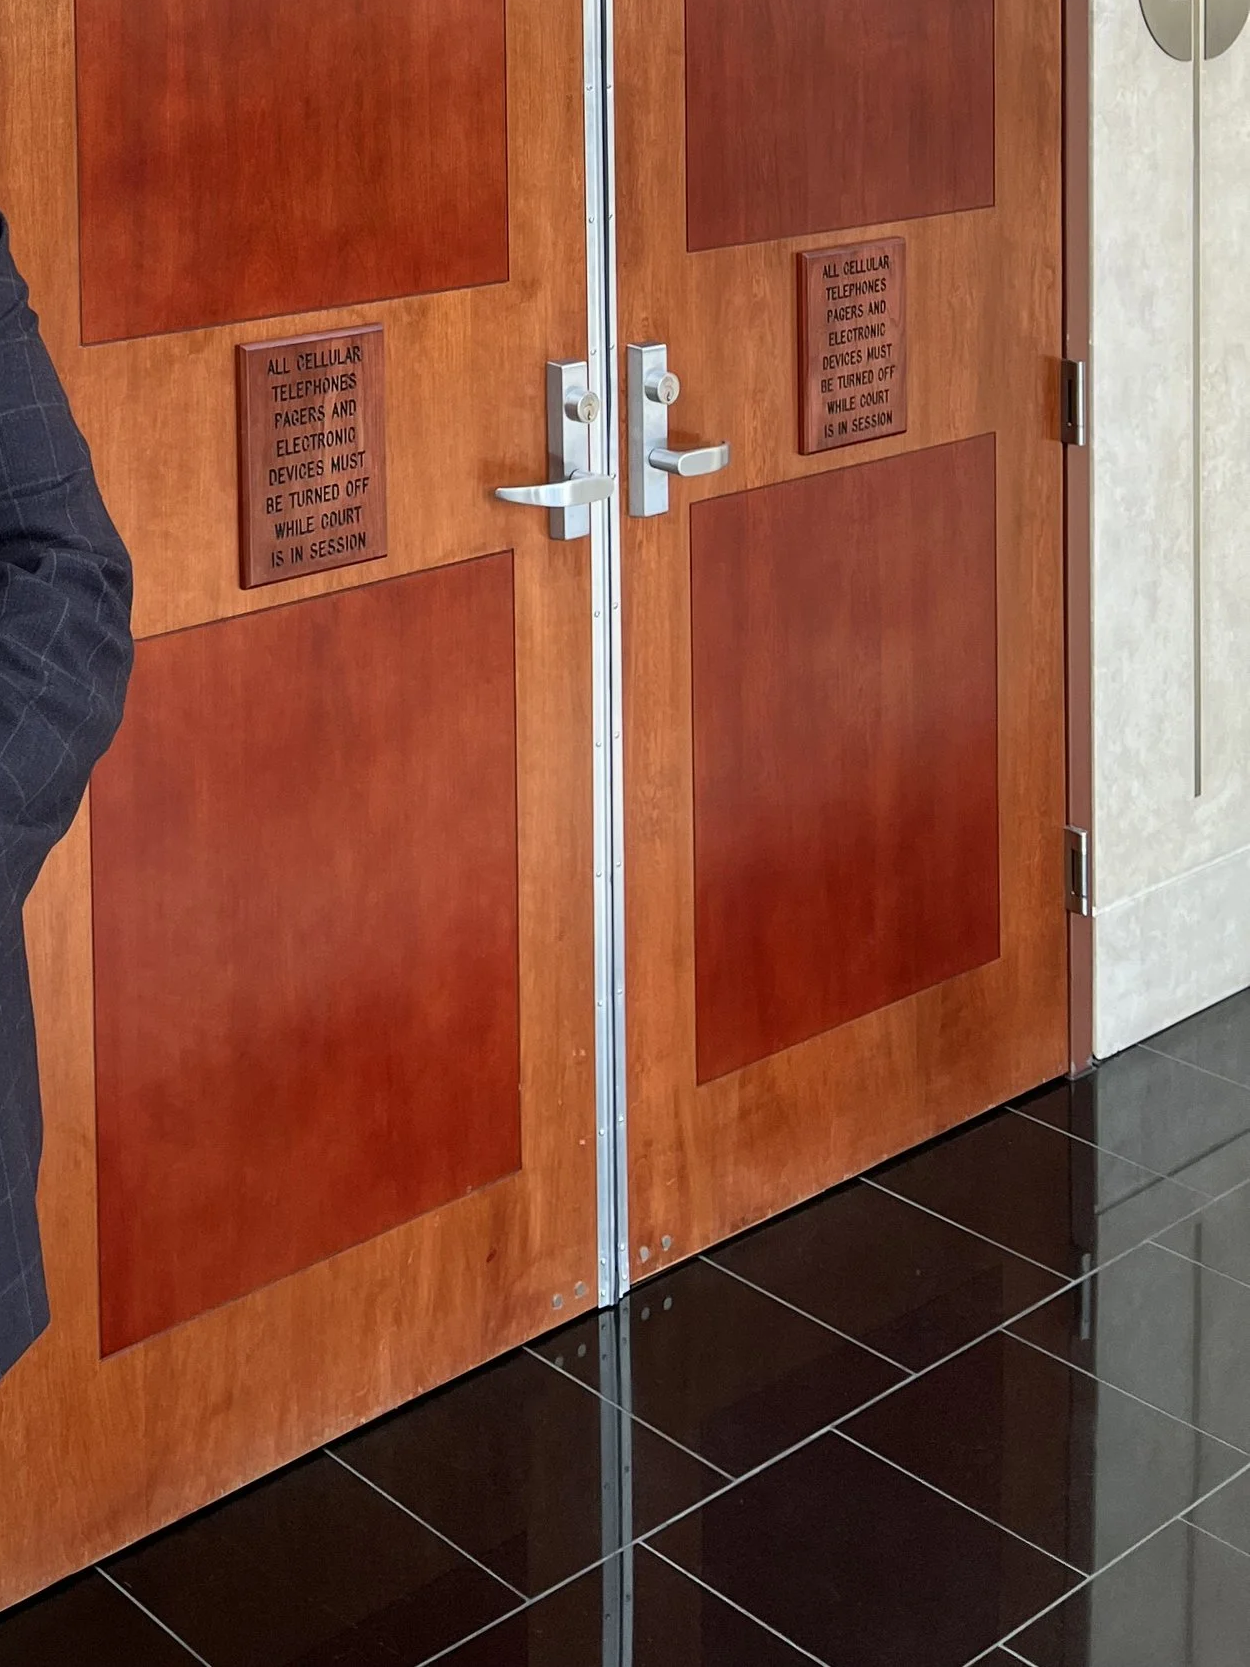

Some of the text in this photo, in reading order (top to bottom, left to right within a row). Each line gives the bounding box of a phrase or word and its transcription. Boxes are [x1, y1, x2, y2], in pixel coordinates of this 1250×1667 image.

[822, 255, 890, 279] ALL CELLULAR
[826, 278, 887, 301] TELEPHONES
[827, 299, 886, 323] PAGERS AND
[828, 322, 886, 347] ELECTRONIC
[267, 345, 362, 375] ALL CELLULAR
[822, 343, 892, 371] DEVICES MUST
[271, 372, 357, 402] TELEPHONES
[821, 365, 895, 394] BE TURNED OFF
[275, 399, 356, 429] PAGERS AND
[827, 389, 889, 415] WHILE COURT
[824, 410, 893, 439] IS IN SESSION
[277, 427, 356, 457] ELECTRONIC
[269, 451, 366, 486] DEVICES MUST
[266, 477, 370, 514] BE TURNED OFF
[275, 506, 362, 540] WHILE COURT
[271, 532, 366, 568] IS IN SESSION
